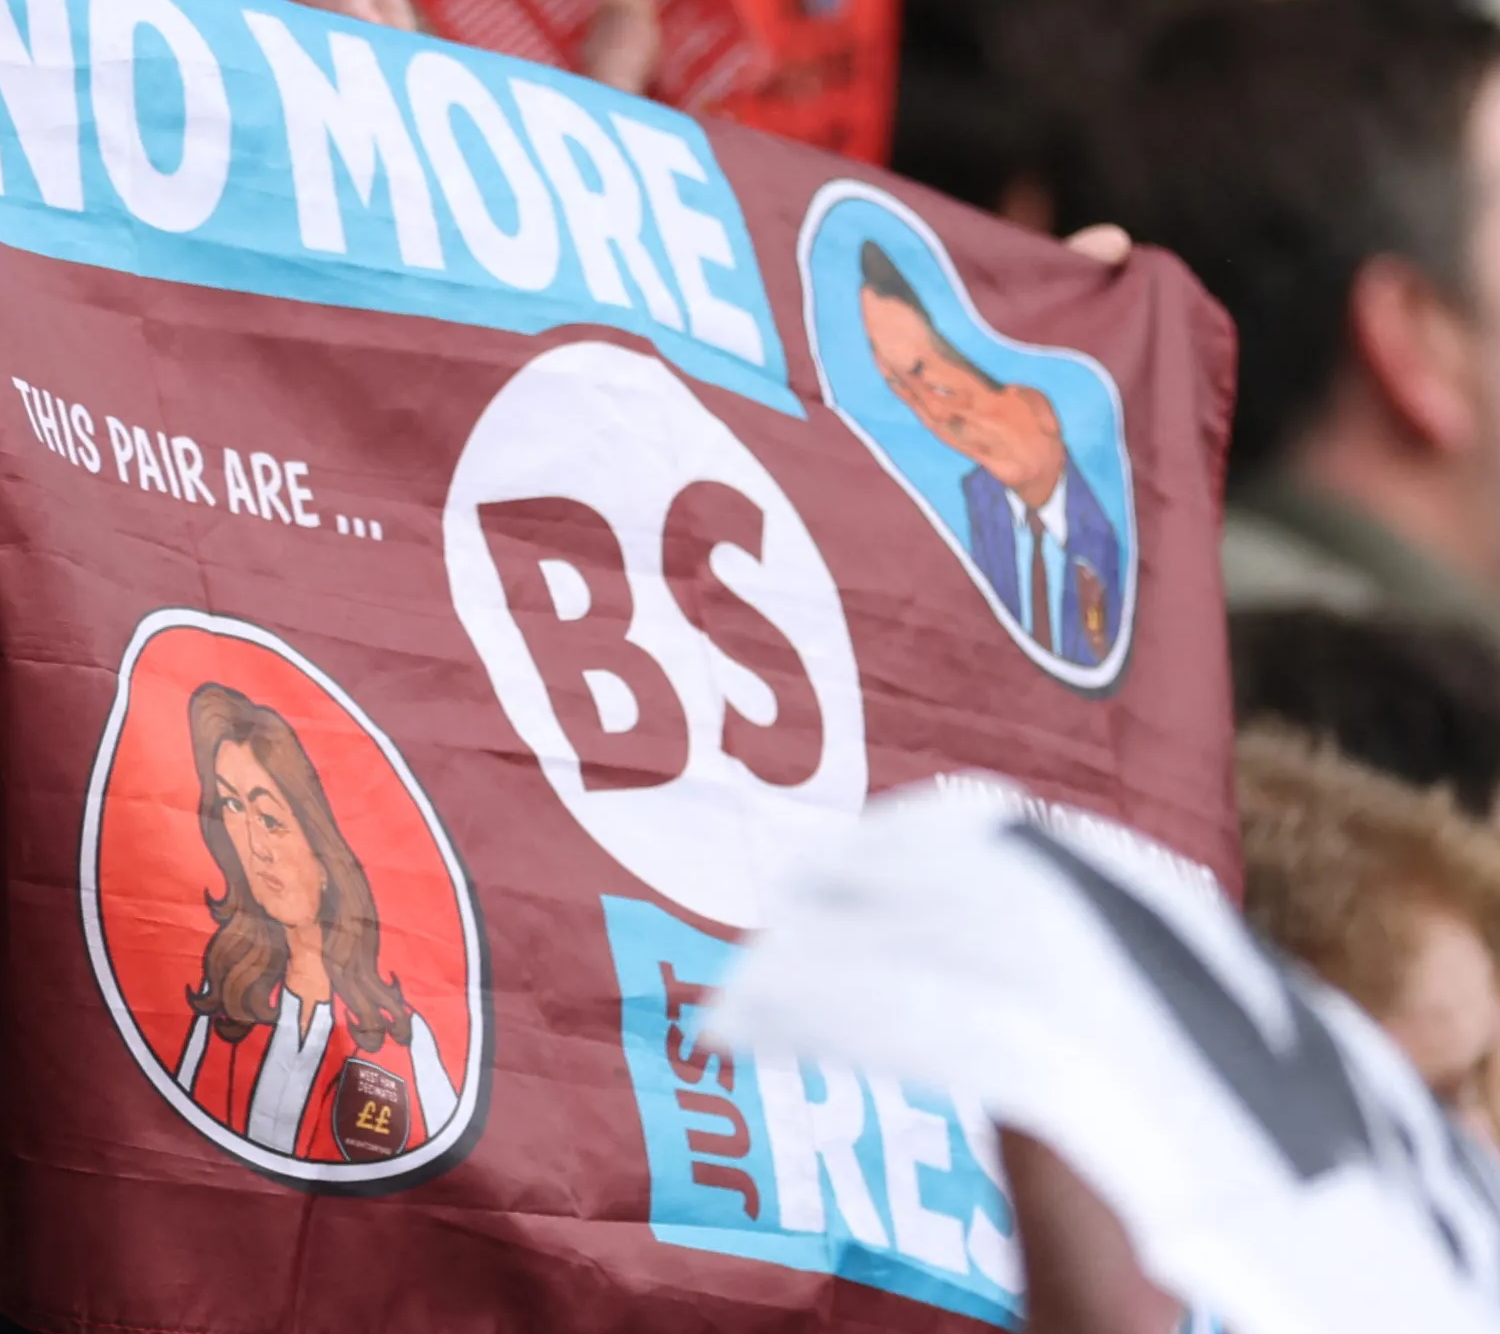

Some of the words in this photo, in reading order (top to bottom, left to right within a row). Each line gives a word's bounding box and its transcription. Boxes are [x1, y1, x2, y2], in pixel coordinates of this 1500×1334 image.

[242, 8, 766, 367] MORE
[11, 376, 100, 474] THIS
[104, 415, 216, 506] PAIR
[224, 448, 320, 527] ARE
[476, 480, 824, 792] BS
[657, 961, 760, 1221] JUST
